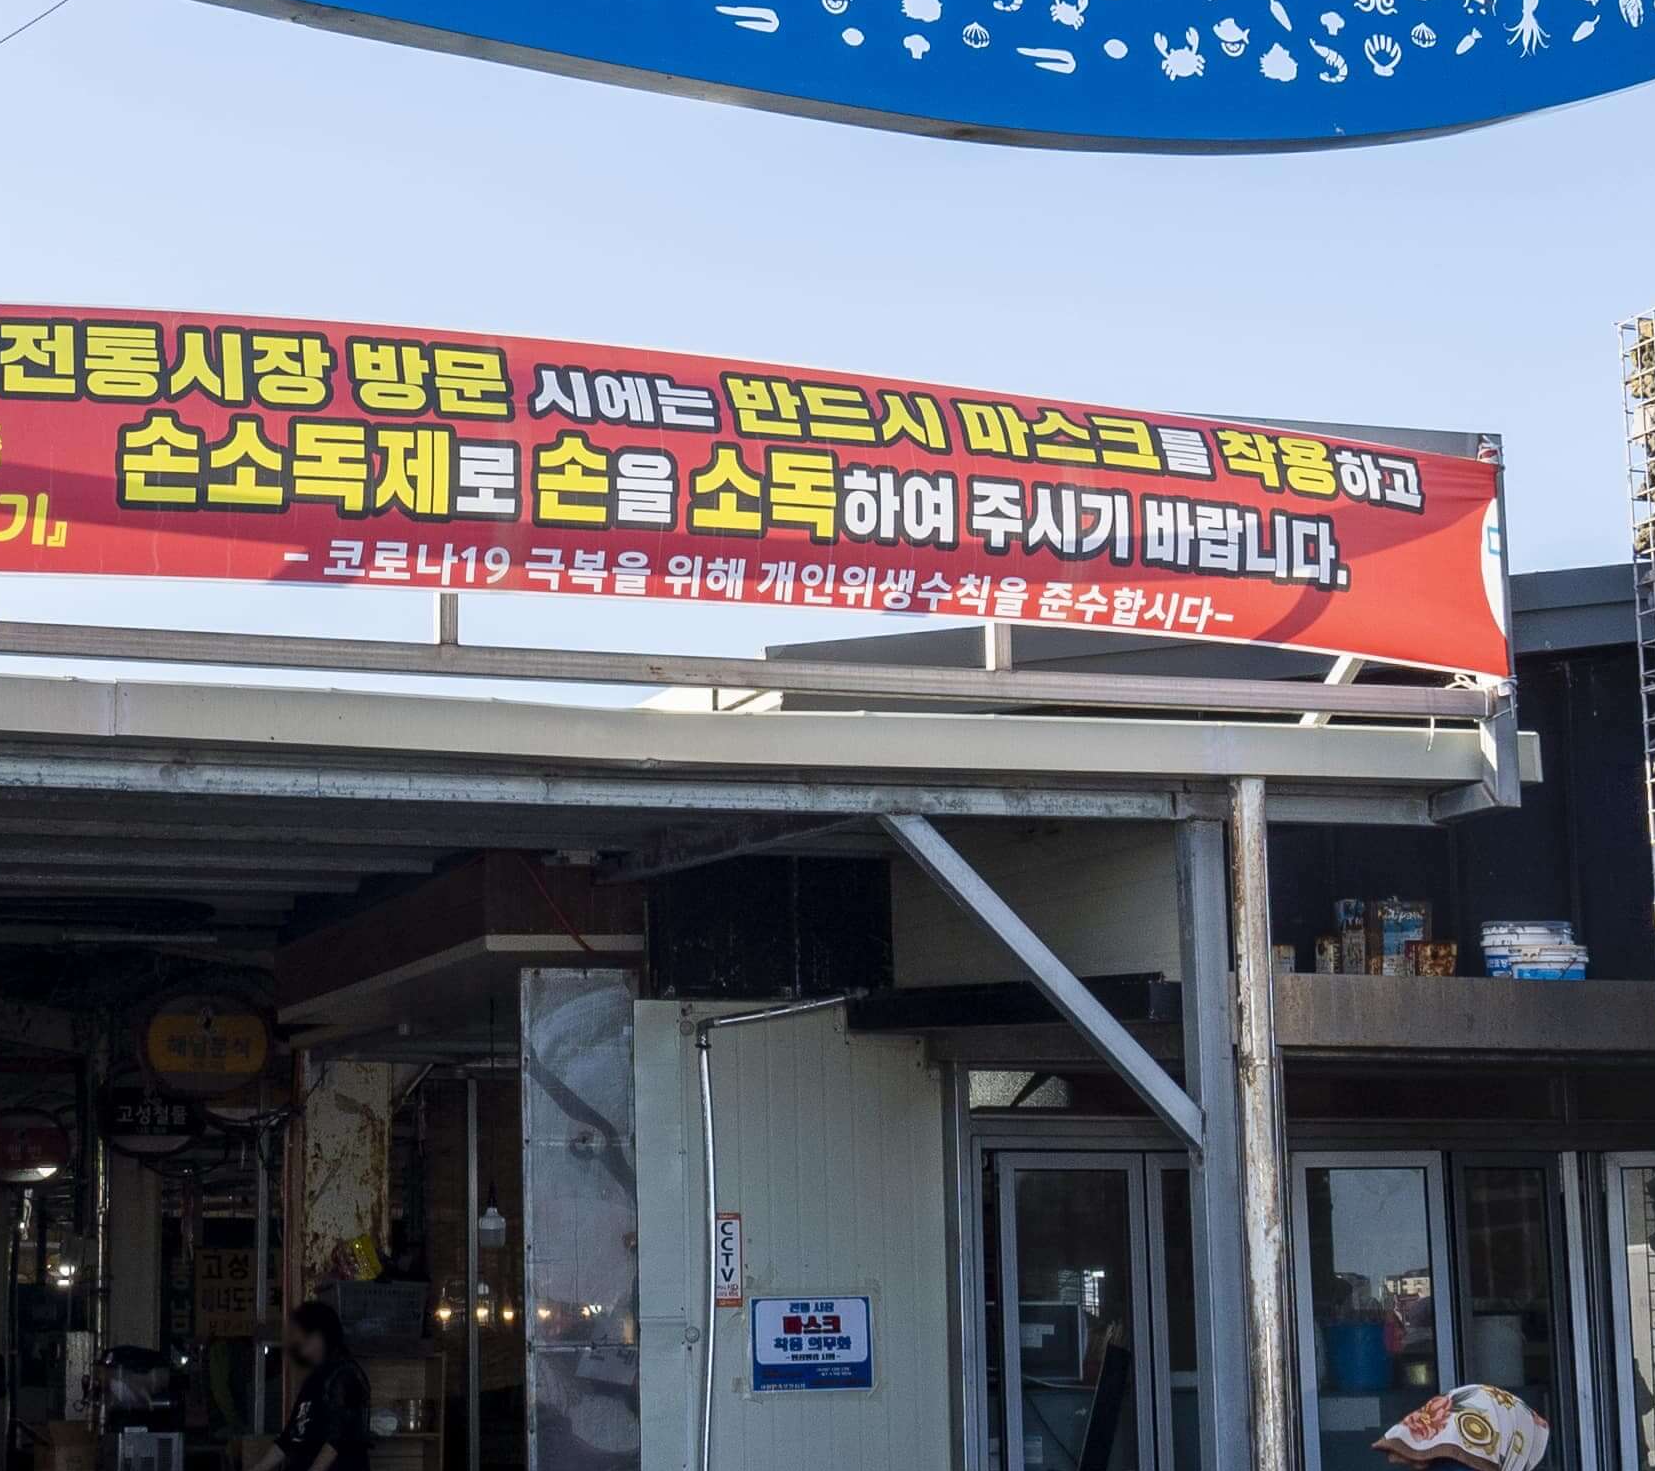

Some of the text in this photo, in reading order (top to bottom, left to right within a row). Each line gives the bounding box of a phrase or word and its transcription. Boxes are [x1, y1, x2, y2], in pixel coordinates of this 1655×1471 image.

[352, 339, 510, 417] 방문
[533, 366, 719, 428] 시에는
[726, 374, 947, 452] 반드시
[960, 396, 1216, 478] 마스크를
[1219, 428, 1426, 510] 착용하고
[122, 415, 1351, 588] 손소독제로 손을 소독하여 주시기 바랍니다.
[322, 539, 512, 586] 코로나19
[527, 545, 653, 596] 극복을
[665, 554, 745, 605] 위해
[756, 562, 1028, 620] 개인위생수칙을
[721, 1221, 735, 1282] CCTV
[774, 1336, 803, 1352] 착용
[783, 1315, 841, 1335] 마스크
